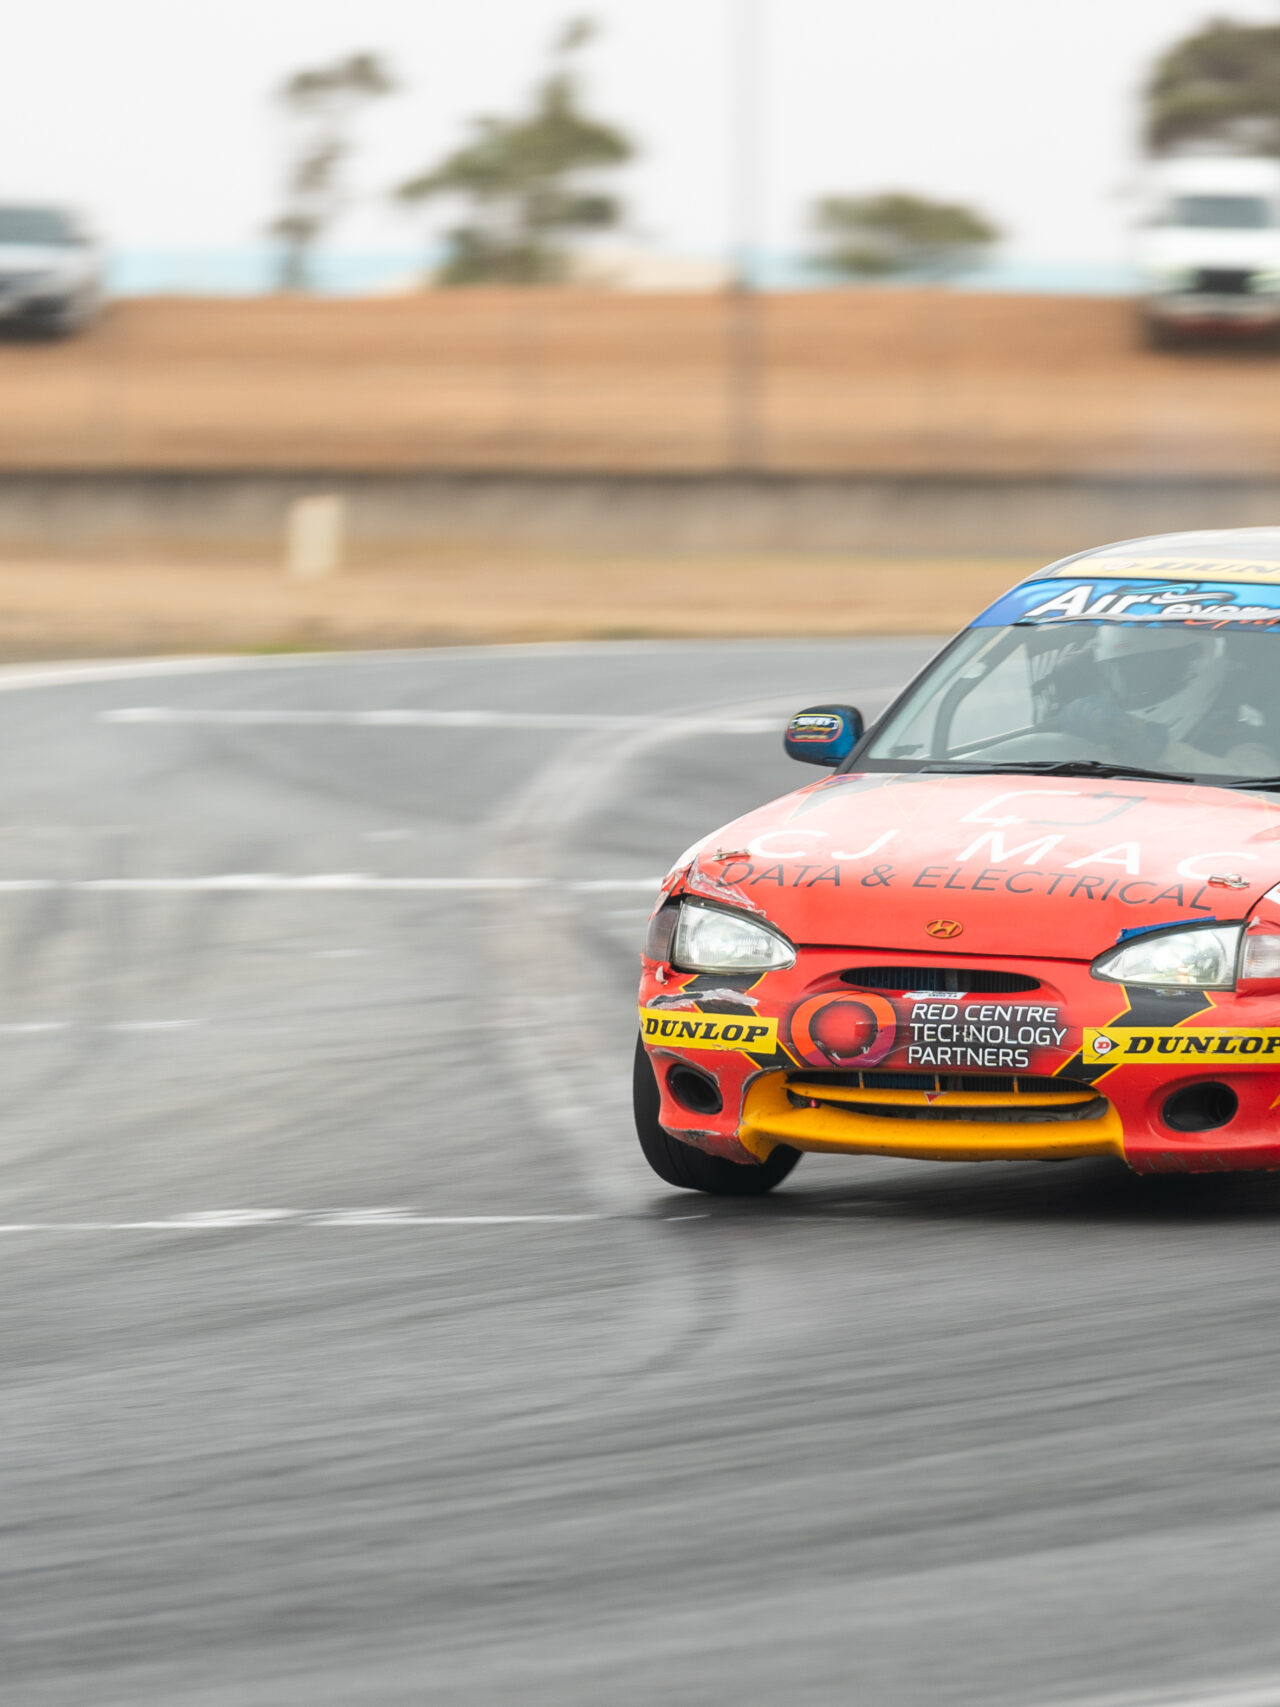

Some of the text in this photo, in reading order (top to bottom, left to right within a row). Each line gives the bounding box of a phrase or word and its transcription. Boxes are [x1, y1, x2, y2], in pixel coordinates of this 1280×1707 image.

[1024, 585, 1153, 617] Air
[748, 829, 1259, 882] CJ MAC
[716, 862, 1212, 912] DATA & ELECTRICAL
[911, 1003, 1059, 1023] RED CENTRE
[645, 1018, 769, 1043] DUNLOP
[909, 1023, 1068, 1046] TECHNOLOGY
[908, 1046, 1030, 1068] PARTNERS
